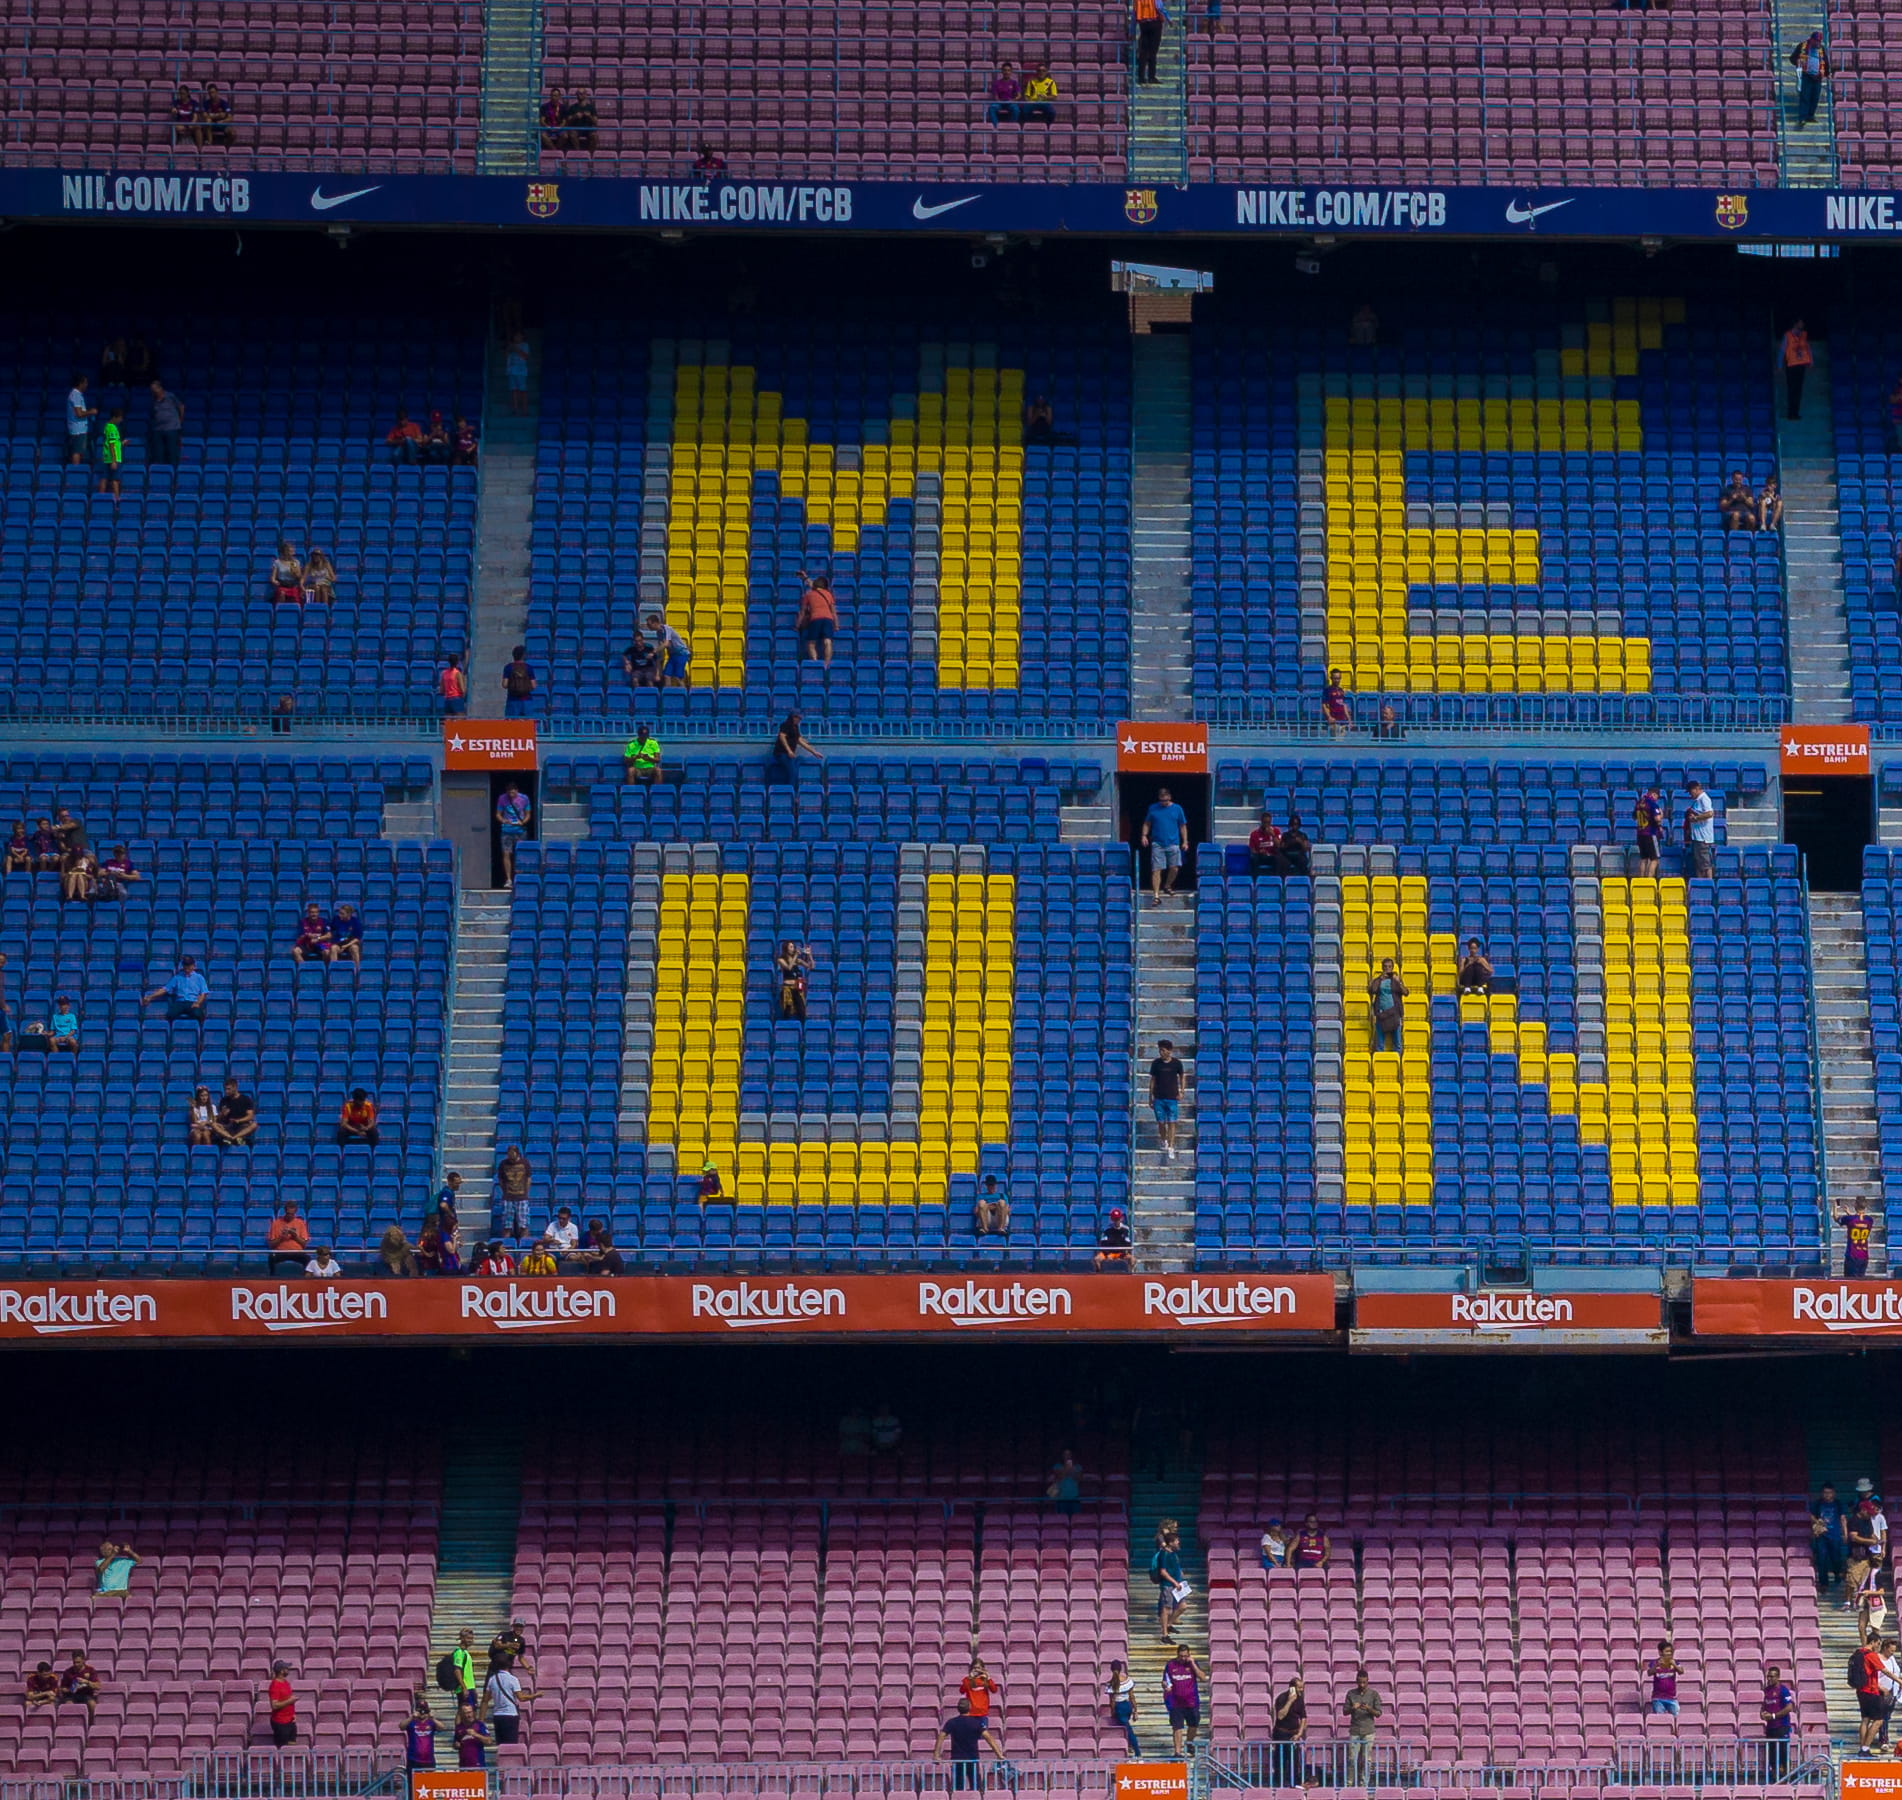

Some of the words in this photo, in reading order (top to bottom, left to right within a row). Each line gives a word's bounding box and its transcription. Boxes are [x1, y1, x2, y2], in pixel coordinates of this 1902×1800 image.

[640, 186, 852, 222] NIKE.COM/FCB
[1236, 189, 1447, 226] NIKE.COM/FCB
[468, 738, 535, 751] ESTRELLA
[1140, 741, 1206, 754] ESTRELLA
[1803, 743, 1868, 756] ESTRELLA
[648, 874, 1700, 1208] UN
[0, 1288, 157, 1322] Rakuten
[231, 1285, 387, 1320] Rakuten
[461, 1283, 616, 1318] Rakuten
[692, 1282, 846, 1317] Rakuten
[919, 1281, 1072, 1315] Rakuten
[1144, 1280, 1296, 1315] Rakuten
[1451, 1293, 1573, 1321] Rakuten
[432, 1788, 485, 1799] ESTRELLA
[1134, 1779, 1186, 1790] ESTRELLA
